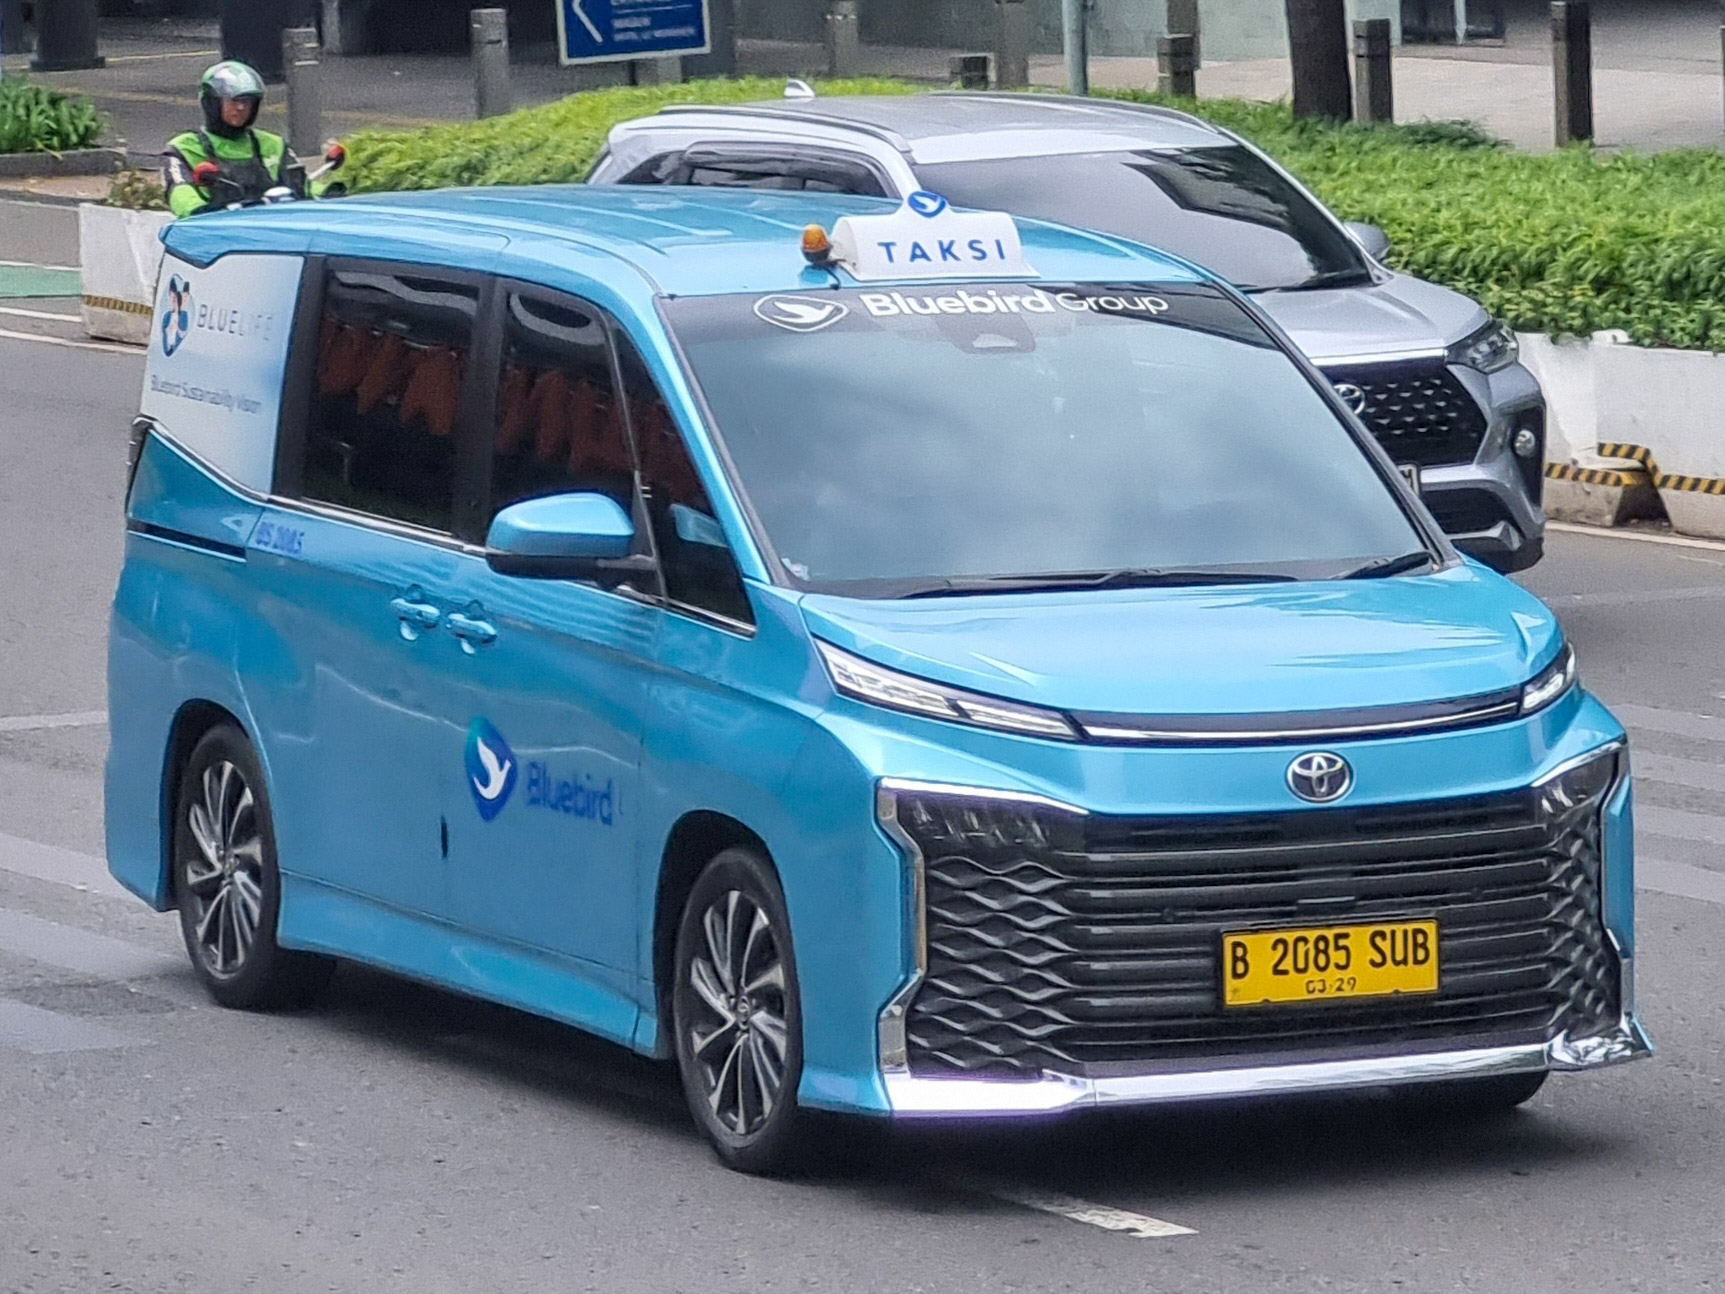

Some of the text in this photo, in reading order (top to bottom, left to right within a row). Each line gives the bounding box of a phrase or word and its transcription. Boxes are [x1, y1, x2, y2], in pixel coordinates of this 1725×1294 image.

[877, 239, 1006, 264] TAKSI
[859, 289, 1170, 317] Bluebird Group
[526, 761, 613, 826] Bluebird
[1230, 927, 1431, 980] B 2085 SUB
